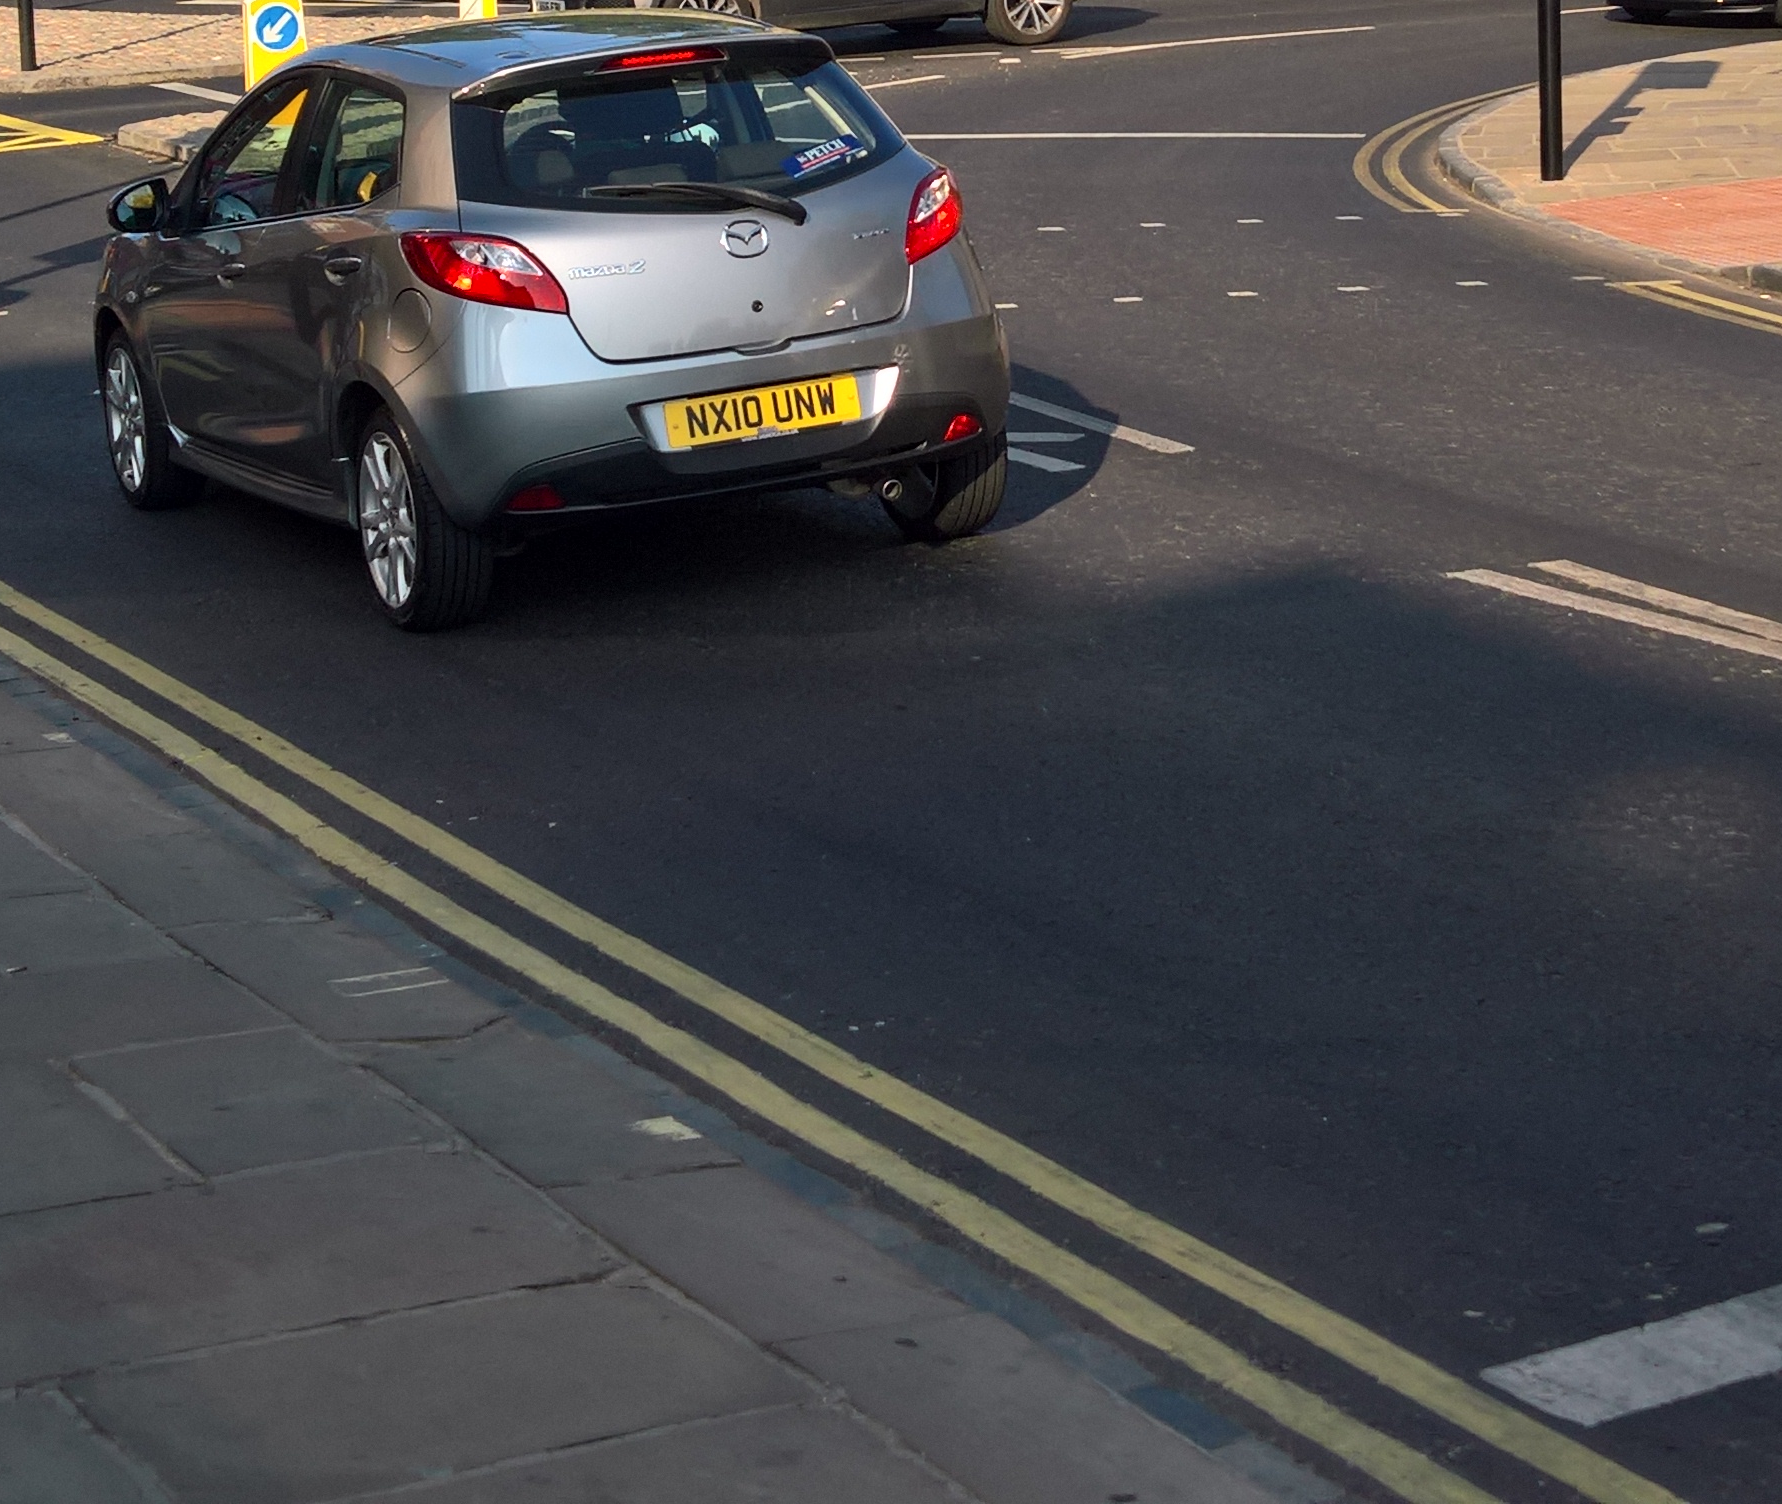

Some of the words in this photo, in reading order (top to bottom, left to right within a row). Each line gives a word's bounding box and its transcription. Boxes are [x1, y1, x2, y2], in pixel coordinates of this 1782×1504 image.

[805, 138, 846, 161] PETCH
[568, 264, 627, 280] mazda
[627, 258, 647, 275] 2
[685, 395, 764, 438] NX10
[771, 382, 836, 424] UNW
